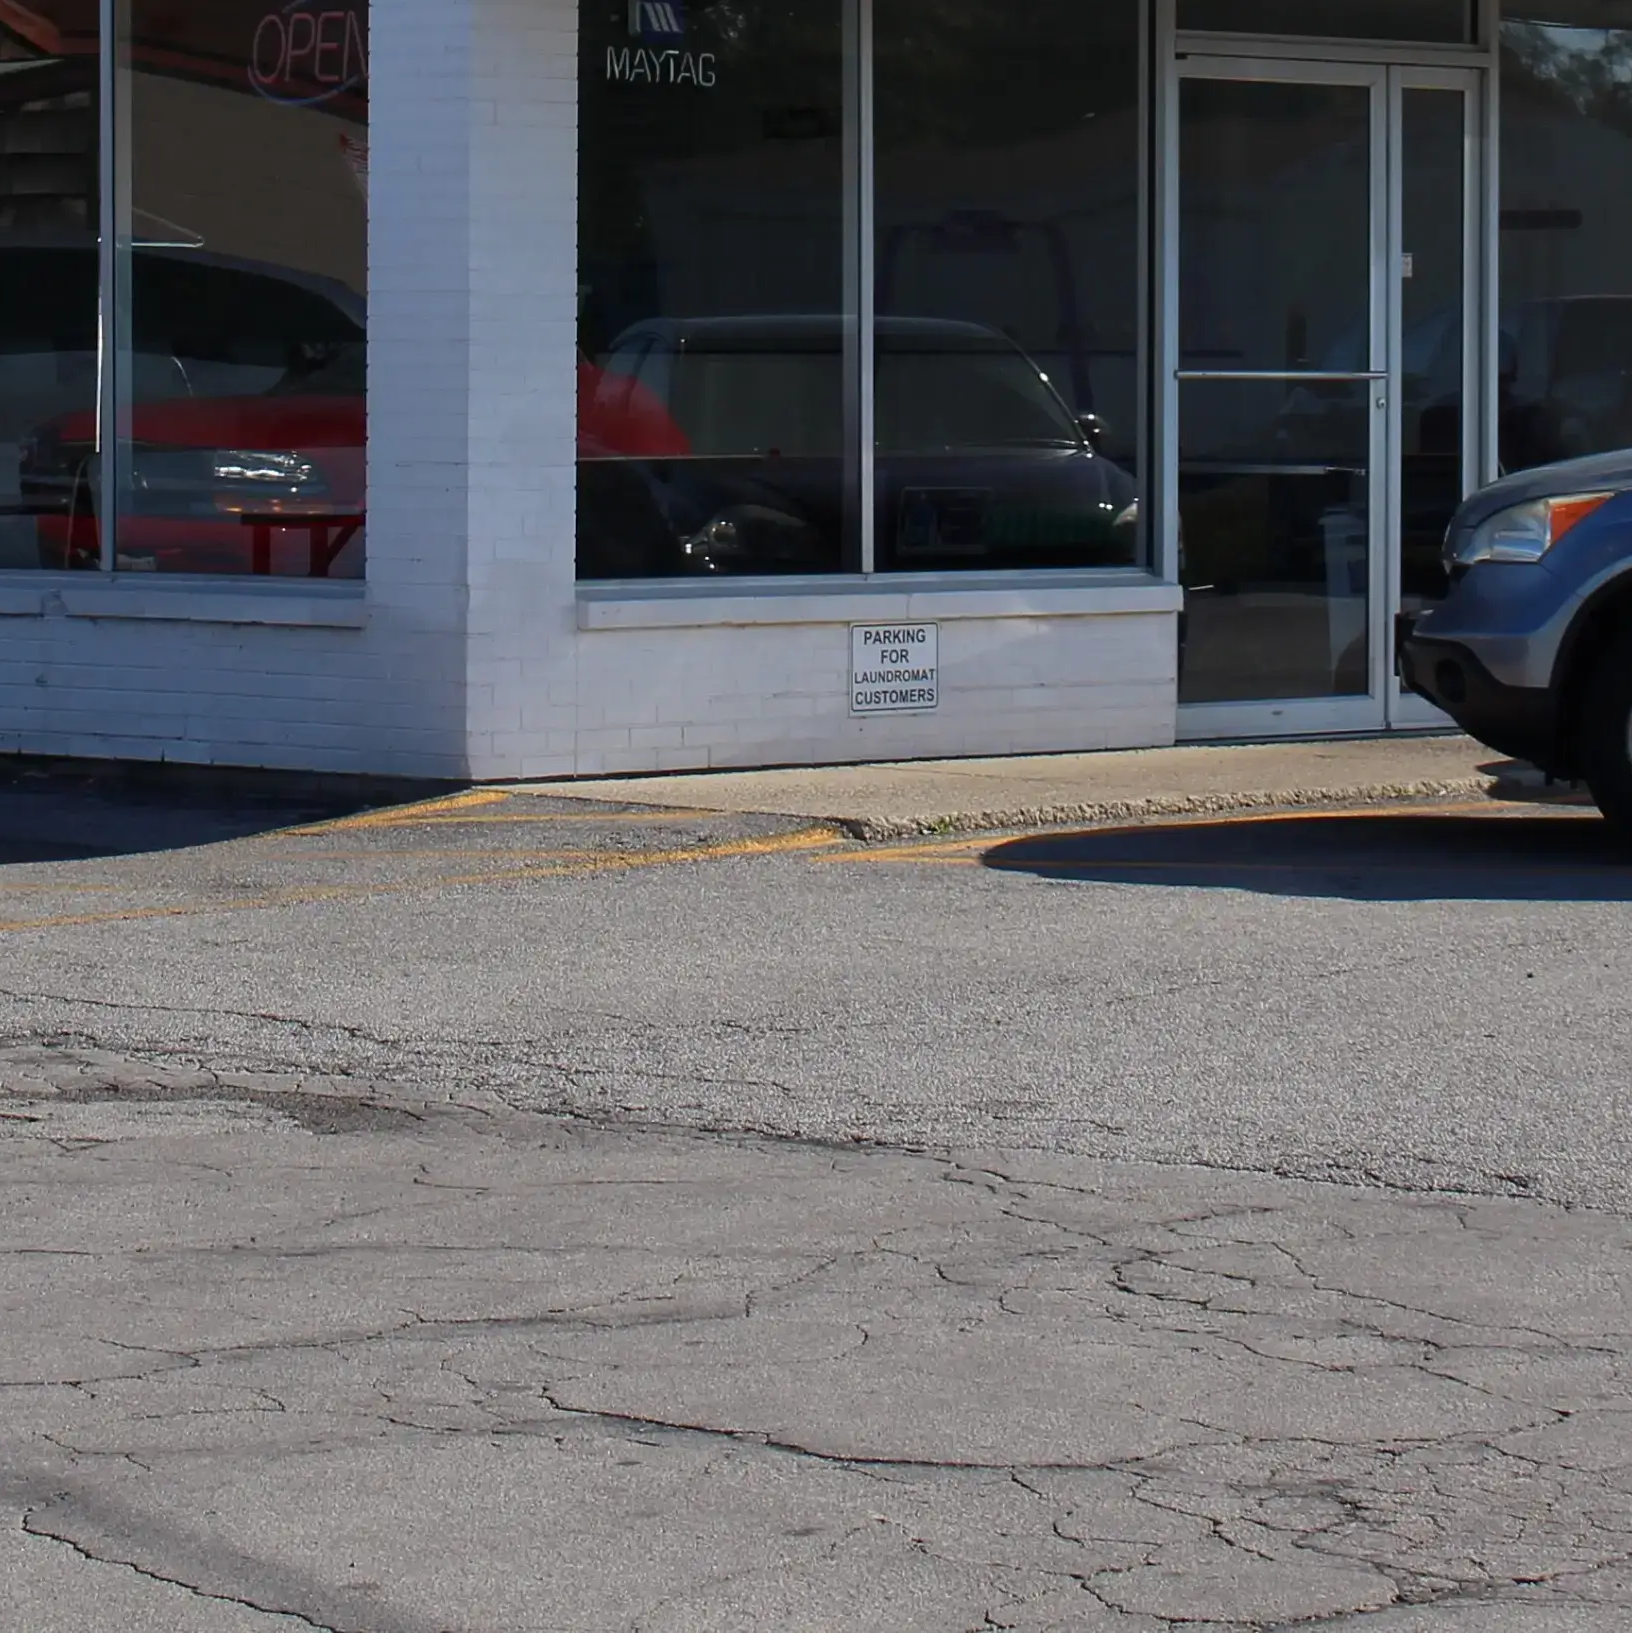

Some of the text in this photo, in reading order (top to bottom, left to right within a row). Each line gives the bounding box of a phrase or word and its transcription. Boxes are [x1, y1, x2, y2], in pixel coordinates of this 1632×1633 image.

[253, 10, 369, 83] OPEN
[607, 46, 715, 86] MAYTAG
[863, 629, 926, 645] PARKING
[881, 649, 909, 664] FOR
[854, 669, 935, 684] LAUNDROMAT
[855, 688, 935, 705] CUSTOMERS
